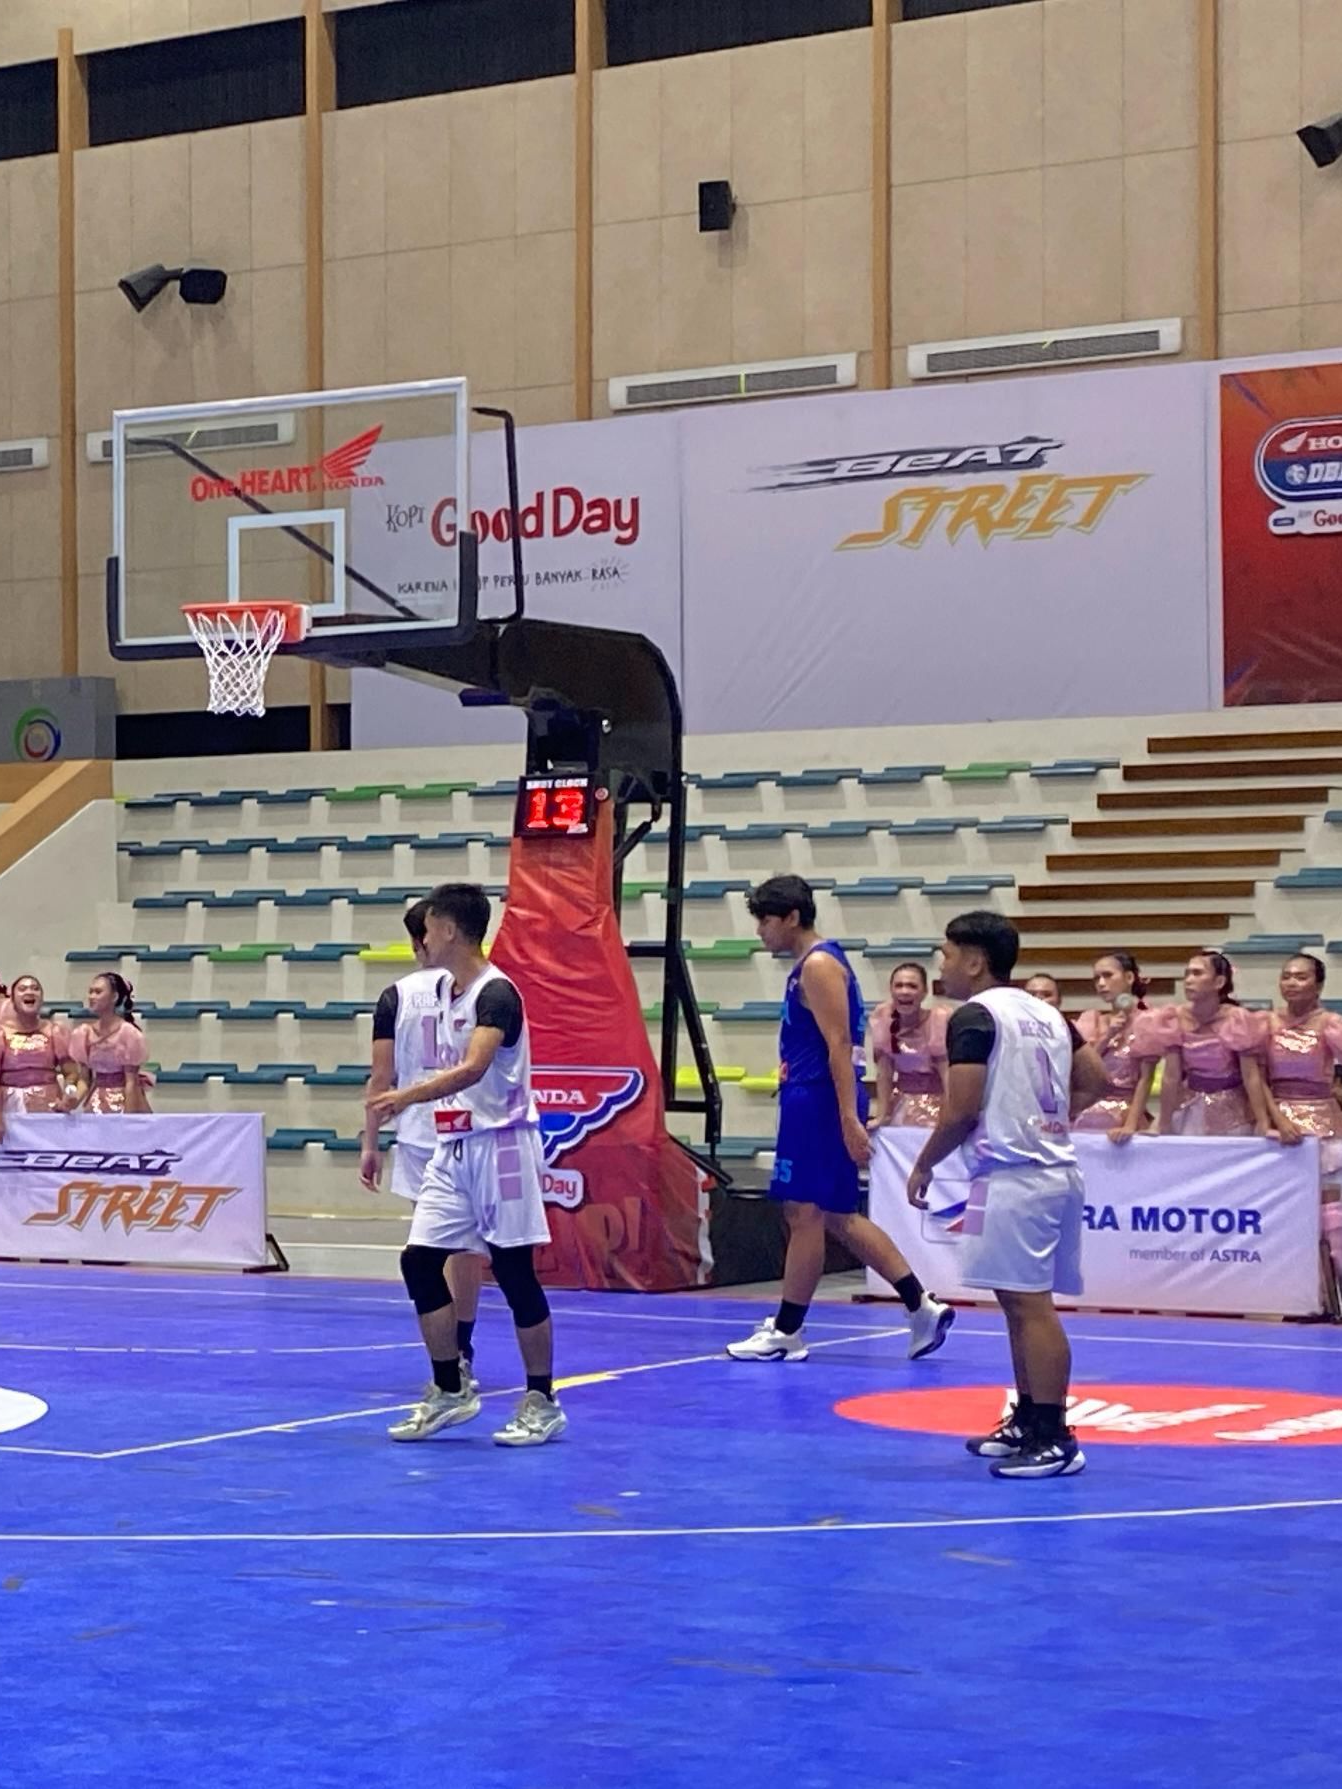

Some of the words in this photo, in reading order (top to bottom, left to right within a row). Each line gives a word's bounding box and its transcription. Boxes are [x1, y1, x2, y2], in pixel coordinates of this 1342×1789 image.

[552, 486, 640, 546] Day
[833, 473, 1156, 551] STREET
[396, 578, 449, 595] KARENA
[534, 569, 583, 586] BANYAK
[591, 566, 620, 581] RASA
[527, 791, 583, 829] 13
[542, 1174, 577, 1200] Day
[23, 1180, 243, 1235] STREET
[1131, 1206, 1263, 1235] MOTOR
[1129, 1247, 1187, 1261] member
[1190, 1248, 1206, 1262] of
[1209, 1249, 1262, 1264] ASTRA
